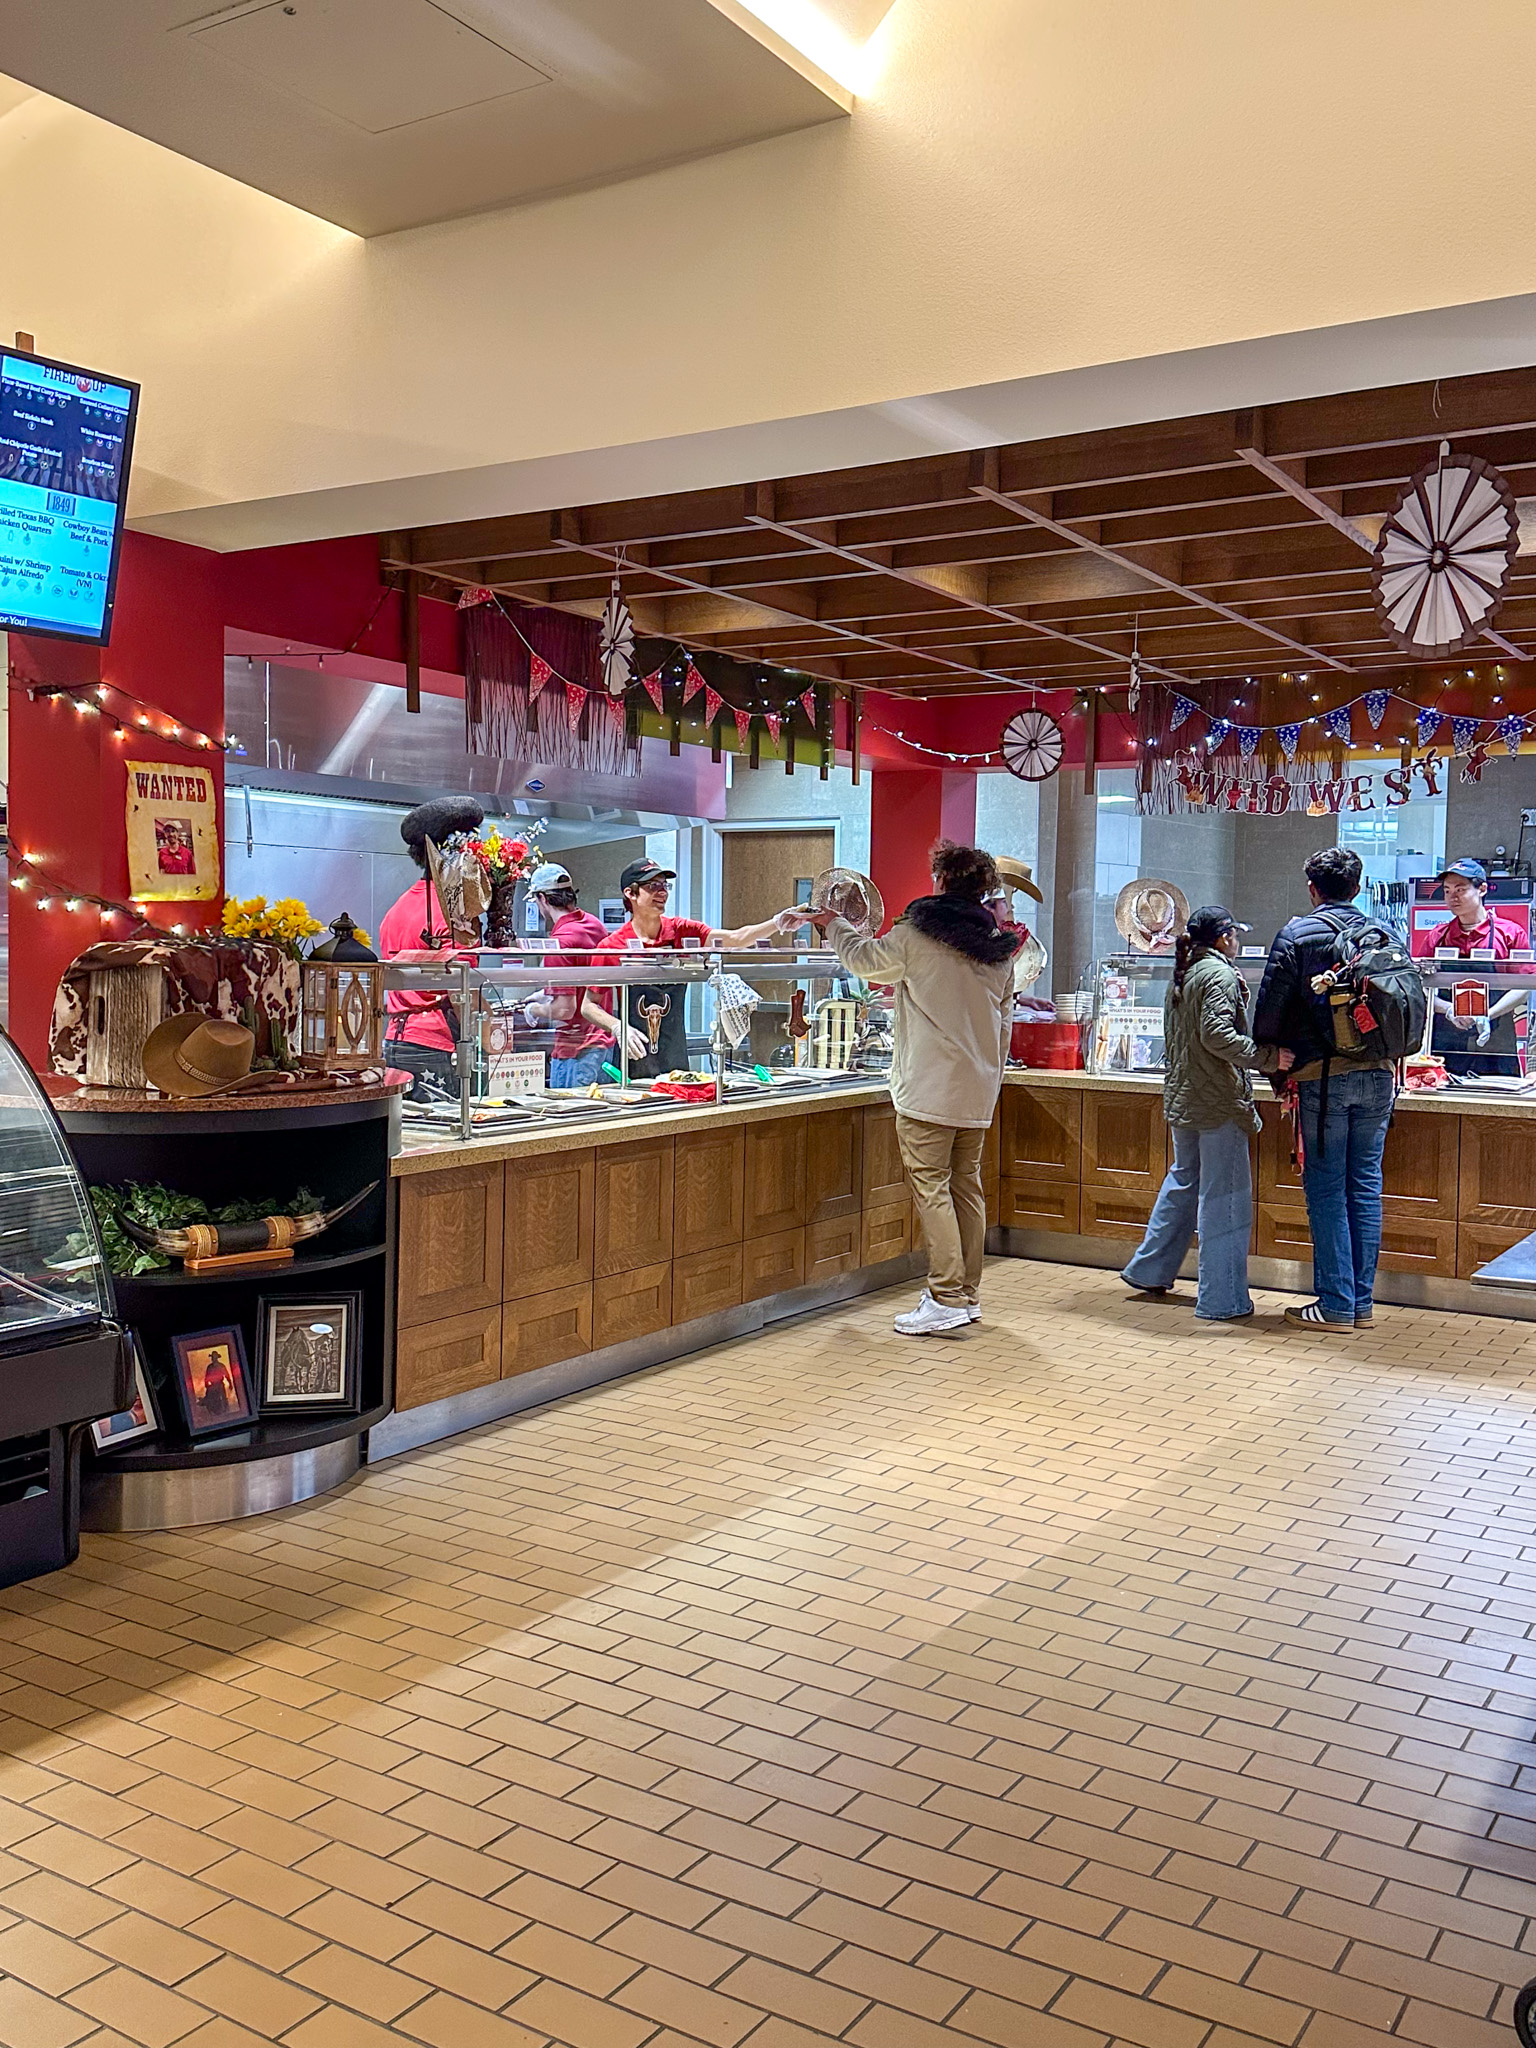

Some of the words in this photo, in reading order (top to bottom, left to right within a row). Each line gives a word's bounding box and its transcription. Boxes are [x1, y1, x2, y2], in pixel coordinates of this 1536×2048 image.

[44, 367, 76, 385] FIRED
[92, 380, 106, 393] UP
[52, 495, 71, 513] 1849
[17, 511, 37, 521] Texas
[38, 515, 55, 525] BBQ
[22, 523, 52, 534] Quarters
[63, 521, 90, 533] Cowboy
[91, 526, 108, 536] Bean
[70, 532, 86, 540] Beef
[86, 535, 93, 543] &
[93, 538, 108, 546] Pork
[25, 560, 51, 571] Shrimp
[19, 568, 44, 579] Alfredo
[60, 566, 85, 577] Tomato
[86, 570, 93, 579] &
[93, 572, 107, 583] Okr
[76, 579, 91, 588] (VN)
[9, 616, 28, 626] You!
[135, 772, 207, 803] WANTED
[1306, 753, 1444, 817] WEST
